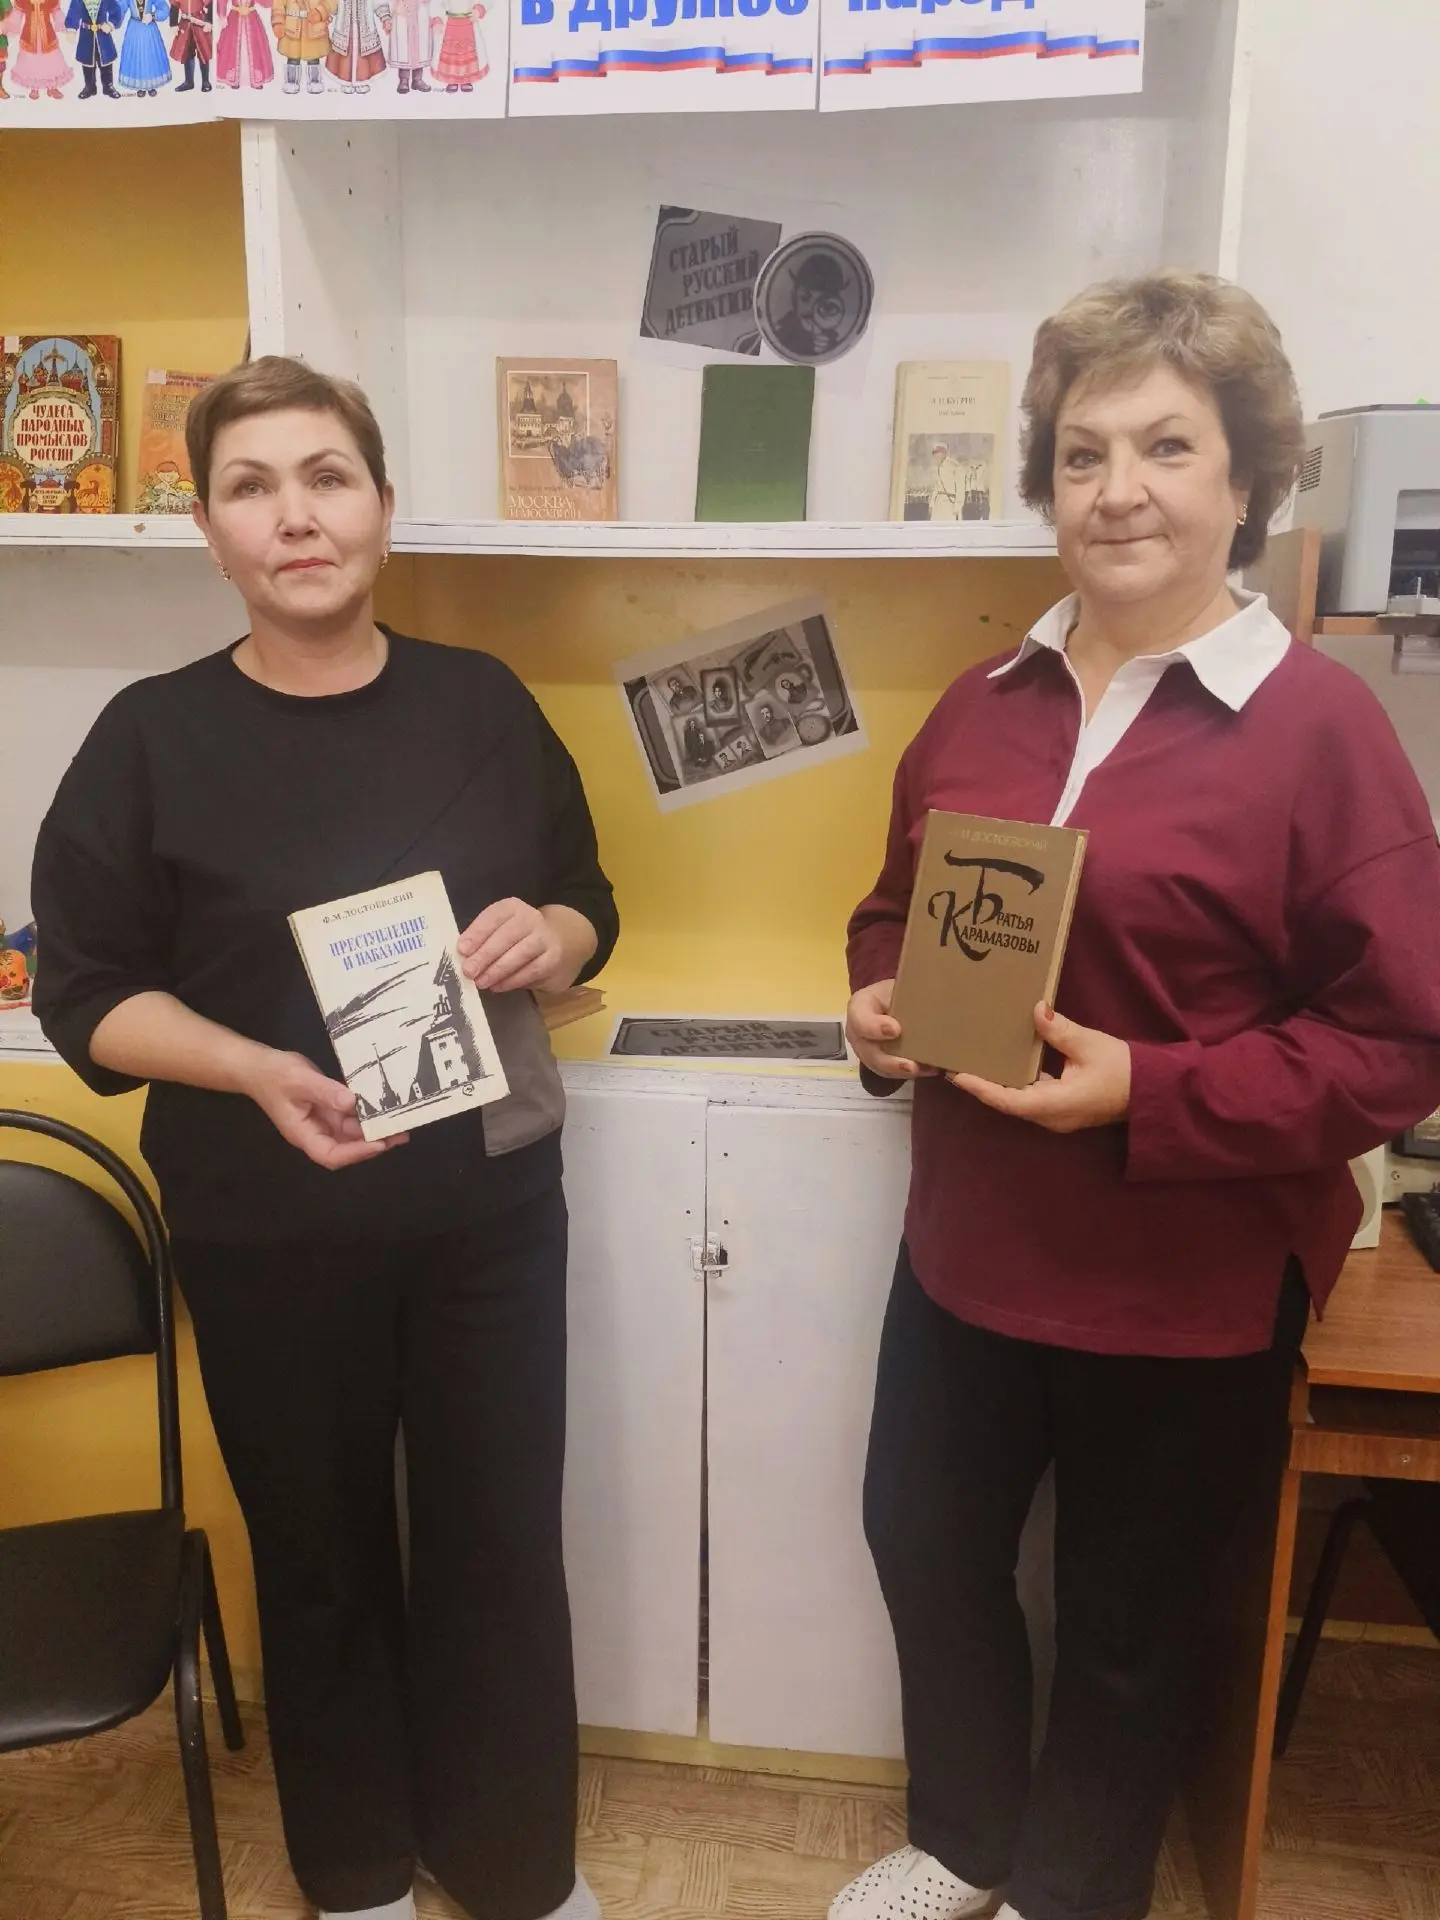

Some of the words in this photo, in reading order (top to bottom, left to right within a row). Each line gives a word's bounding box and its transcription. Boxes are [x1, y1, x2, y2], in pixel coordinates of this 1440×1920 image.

[669, 224, 740, 274] СТАРЫЙ
[682, 249, 759, 297] РУССКИЙ
[32, 404, 74, 418] ЧУДЕСА
[20, 419, 85, 432] НАРОДНЫХ
[16, 434, 88, 447] ПРОМЫСЛОВ
[30, 448, 73, 461] РОССИИ
[329, 915, 429, 957] ПРЕСТУПЛЕНИЕ
[343, 955, 354, 971] И
[355, 934, 427, 966] НАКАЗАНИЕ
[651, 1022, 772, 1037] СТАРЫЙ
